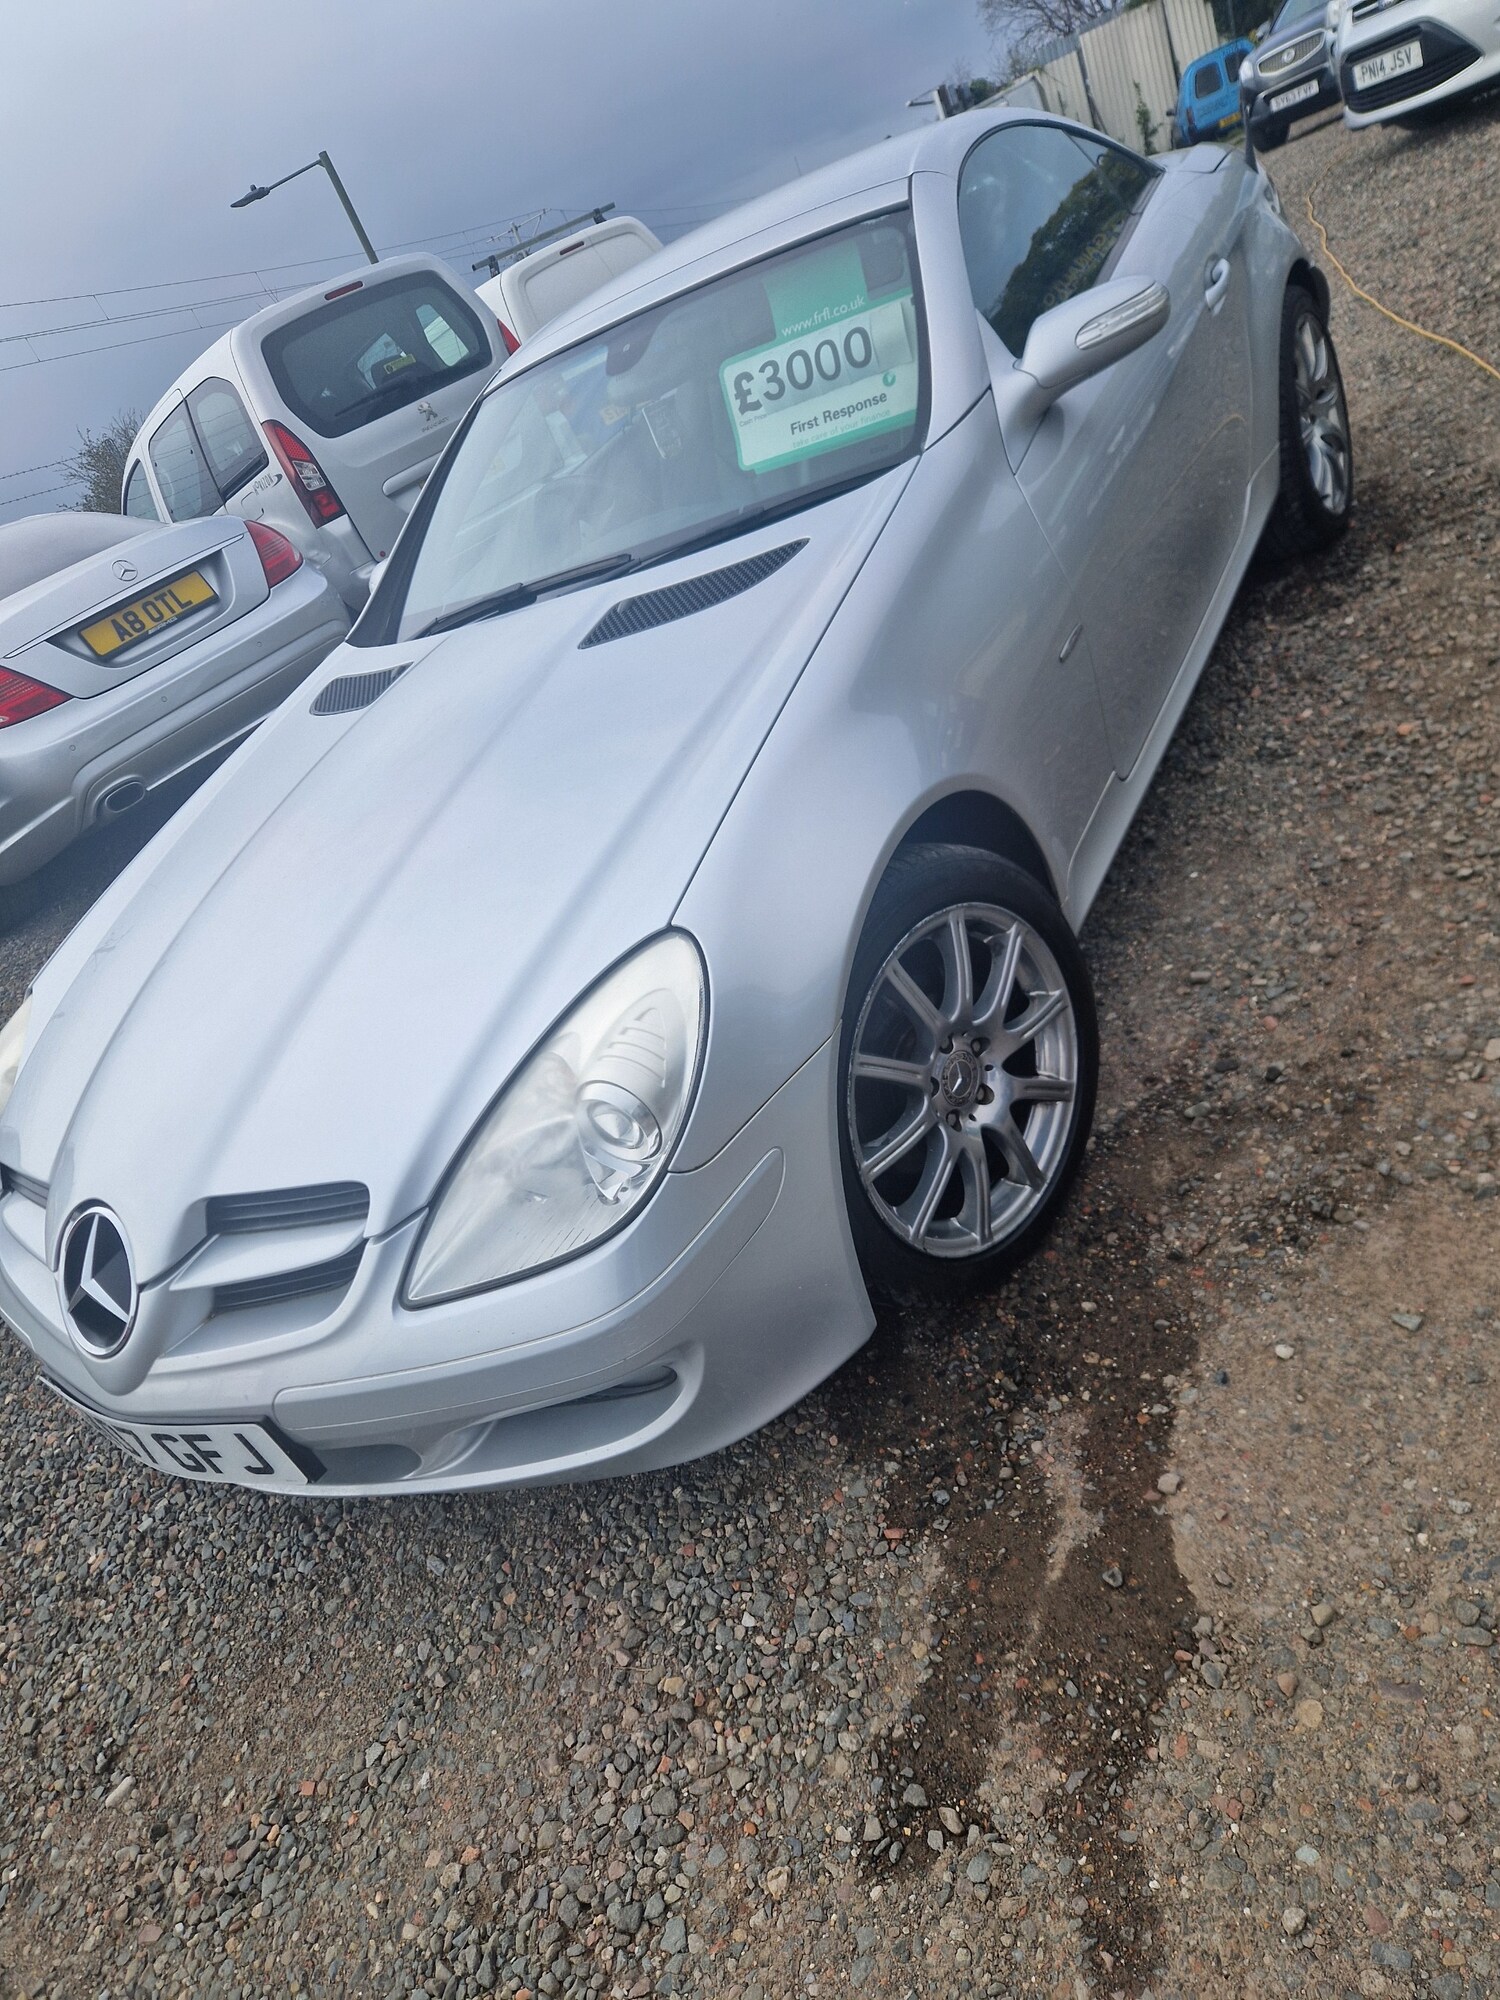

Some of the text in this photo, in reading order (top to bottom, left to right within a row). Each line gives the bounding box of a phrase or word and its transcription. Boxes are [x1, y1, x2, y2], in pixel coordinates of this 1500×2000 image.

[1361, 47, 1412, 84] PN14 JSV
[782, 294, 866, 337] www.frfl.co.uk
[733, 326, 873, 415] £3000
[790, 392, 888, 435] First Response
[110, 589, 193, 642] A8 OTL
[150, 1432, 275, 1475] GFJ
